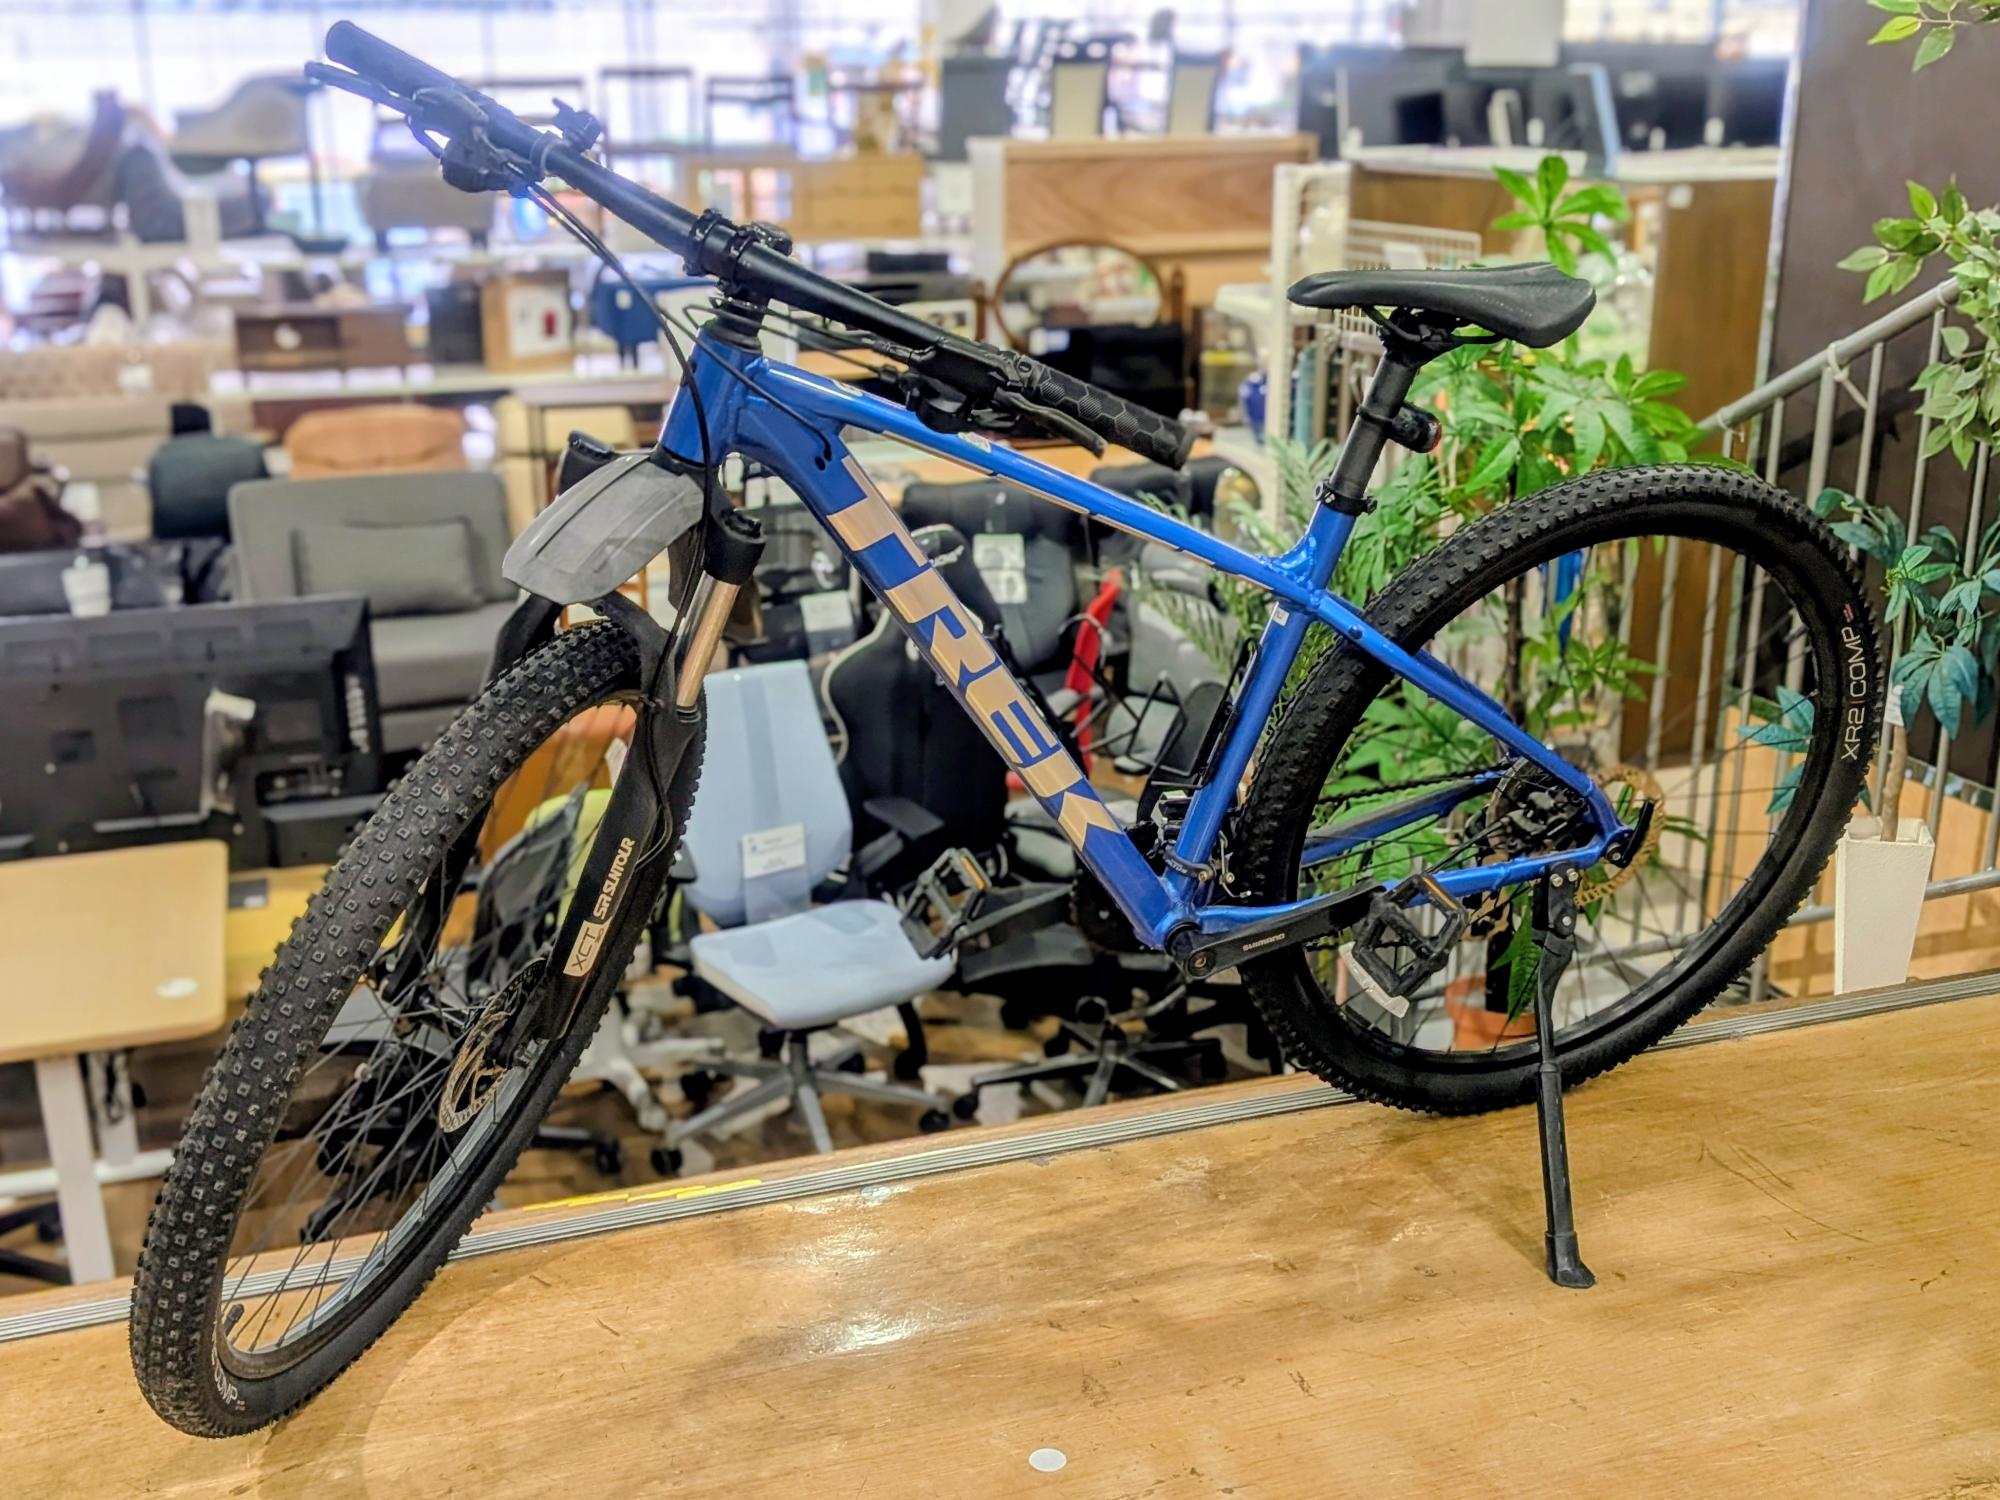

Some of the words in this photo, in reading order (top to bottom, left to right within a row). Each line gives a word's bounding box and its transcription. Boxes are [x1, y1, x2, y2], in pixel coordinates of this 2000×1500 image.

[826, 455, 1120, 851] TREK
[1841, 626, 1867, 698] COMP
[1841, 707, 1865, 760] XR2
[571, 927, 595, 970] XCT
[1242, 932, 1285, 952] SHIMANO
